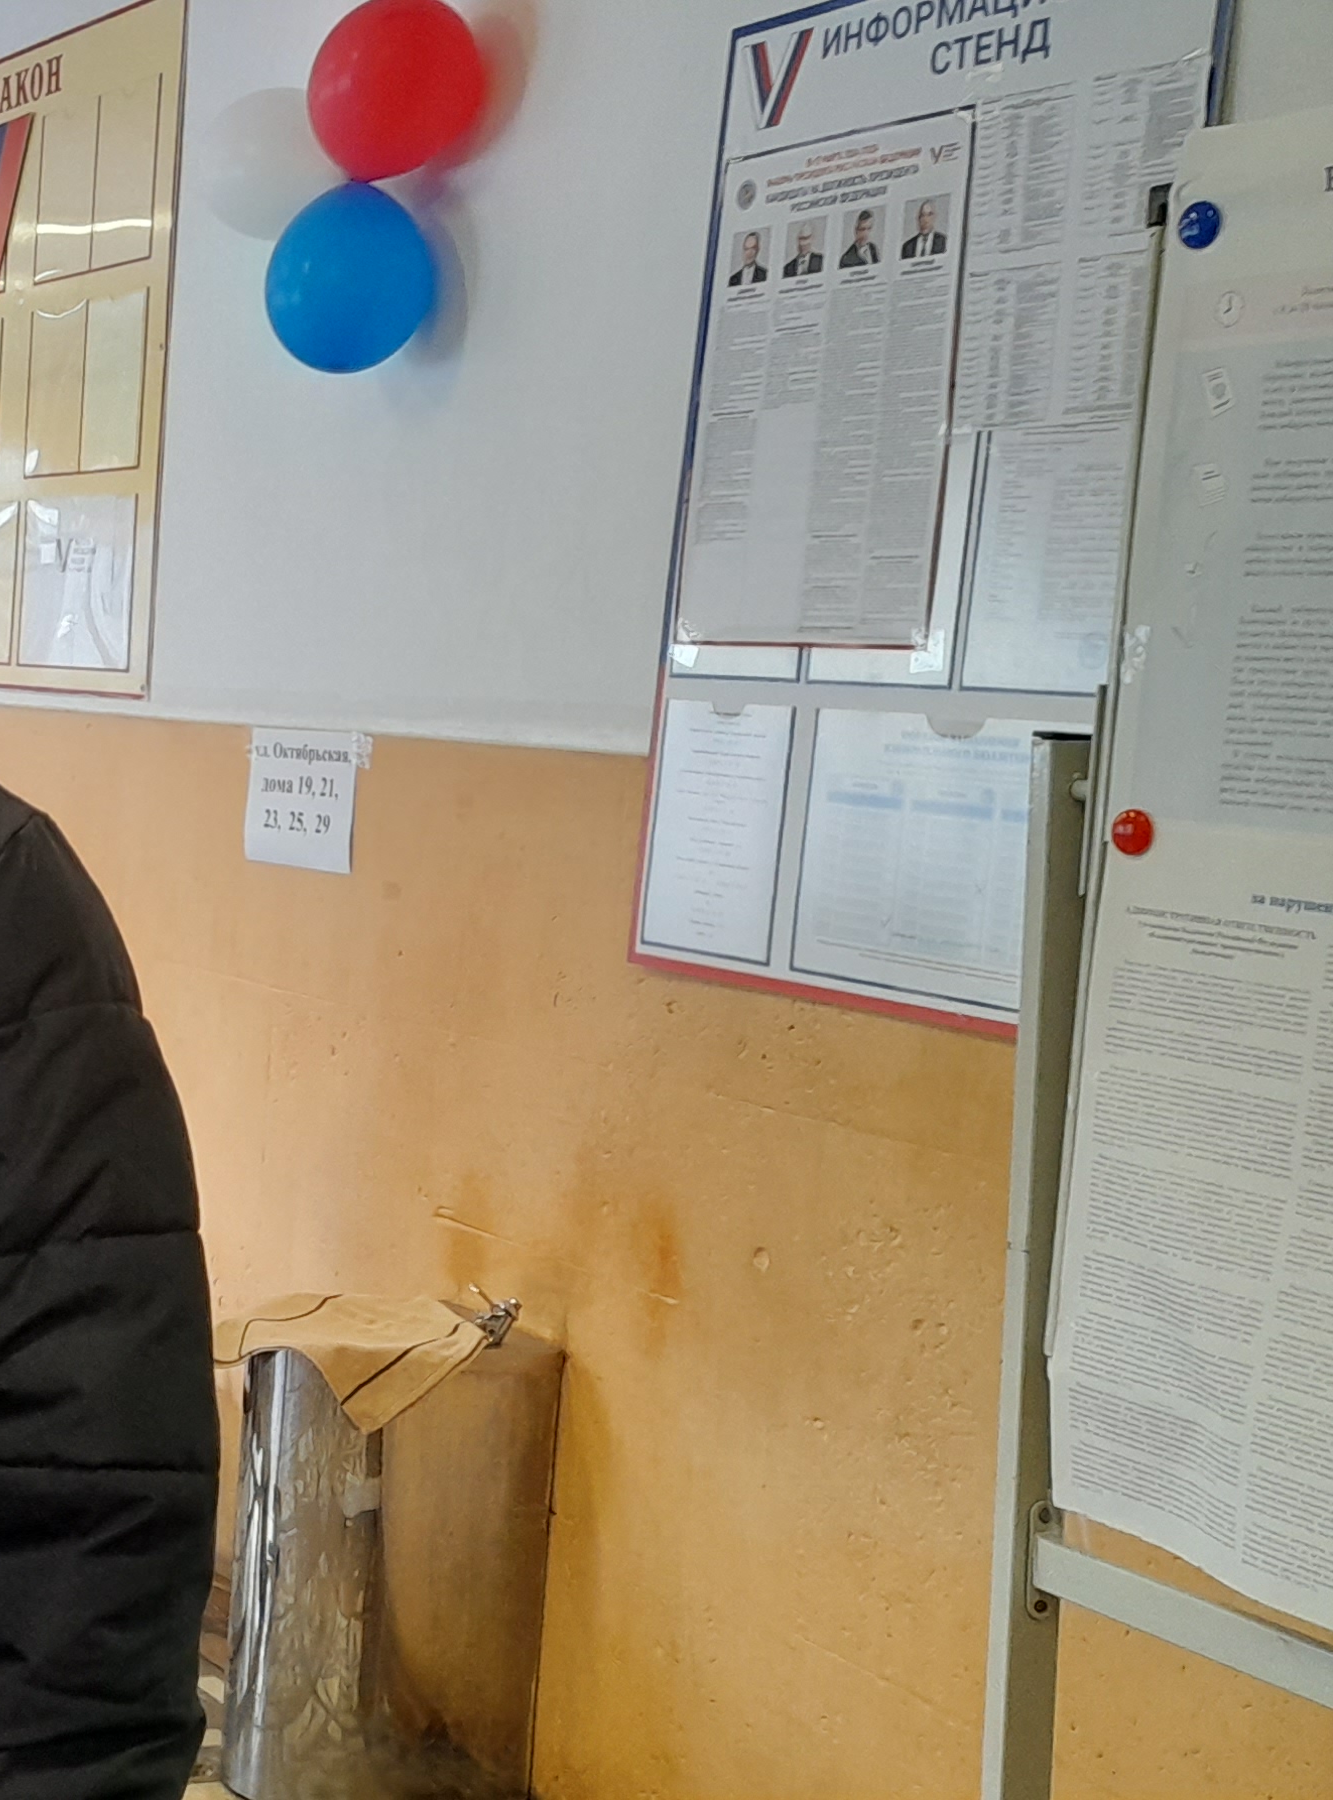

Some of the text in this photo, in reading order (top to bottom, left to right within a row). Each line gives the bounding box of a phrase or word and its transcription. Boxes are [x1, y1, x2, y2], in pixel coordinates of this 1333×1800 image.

[822, 0, 1049, 59] ИНФОРМА
[930, 17, 1052, 75] СТЕНД
[260, 775, 339, 801] дома 19, 21,
[263, 808, 331, 836] 23, 25, 29
